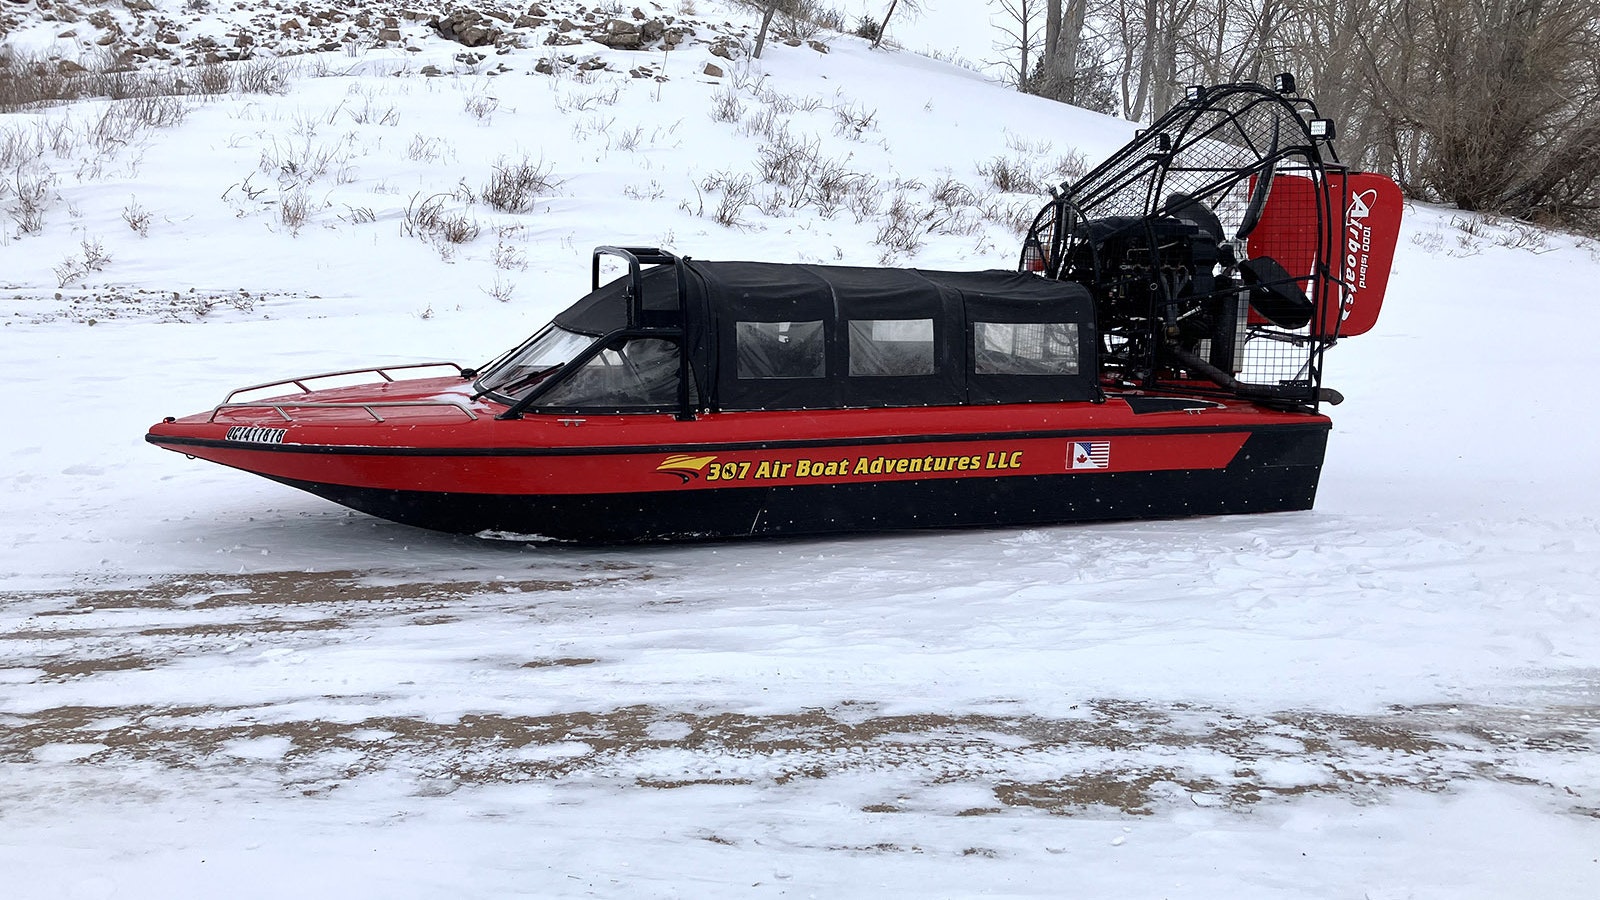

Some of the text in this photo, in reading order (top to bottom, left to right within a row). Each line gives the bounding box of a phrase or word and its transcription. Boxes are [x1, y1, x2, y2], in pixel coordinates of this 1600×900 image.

[1345, 190, 1369, 305] Airboats
[1359, 226, 1371, 289] 1000 Island
[706, 450, 1024, 481] 307 Air Boat Adventures LLC
